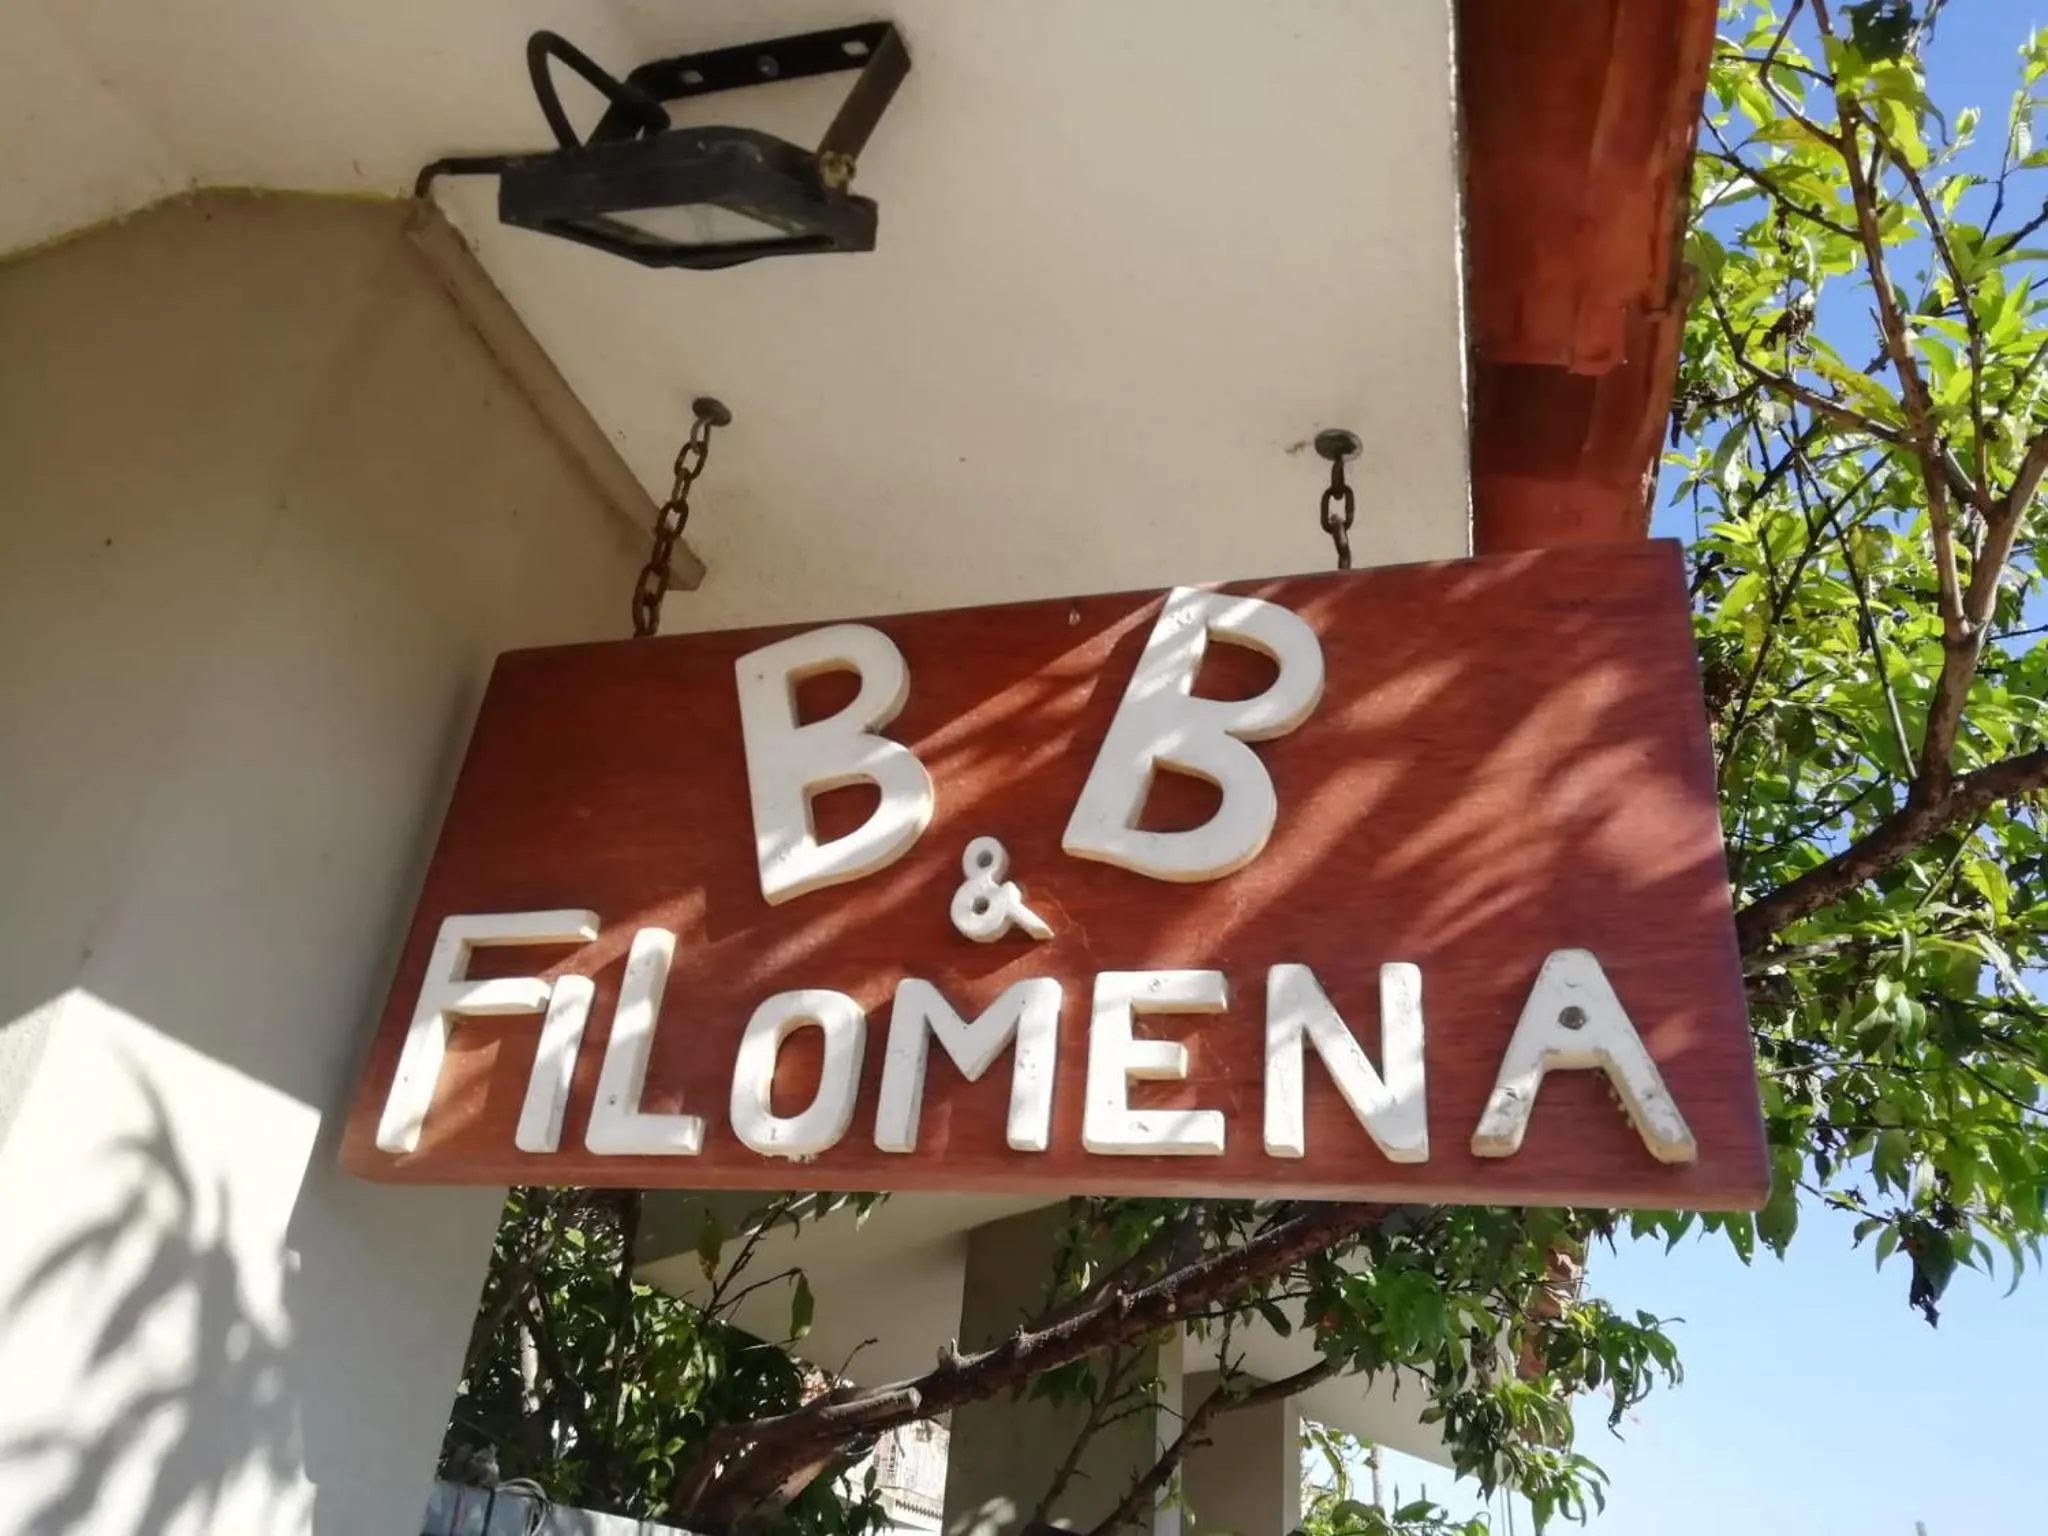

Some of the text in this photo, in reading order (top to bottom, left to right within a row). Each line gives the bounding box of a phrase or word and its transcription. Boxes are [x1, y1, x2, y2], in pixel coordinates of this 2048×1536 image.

[735, 586, 1325, 943] B & B
[376, 909, 1697, 1163] FILOMENA
